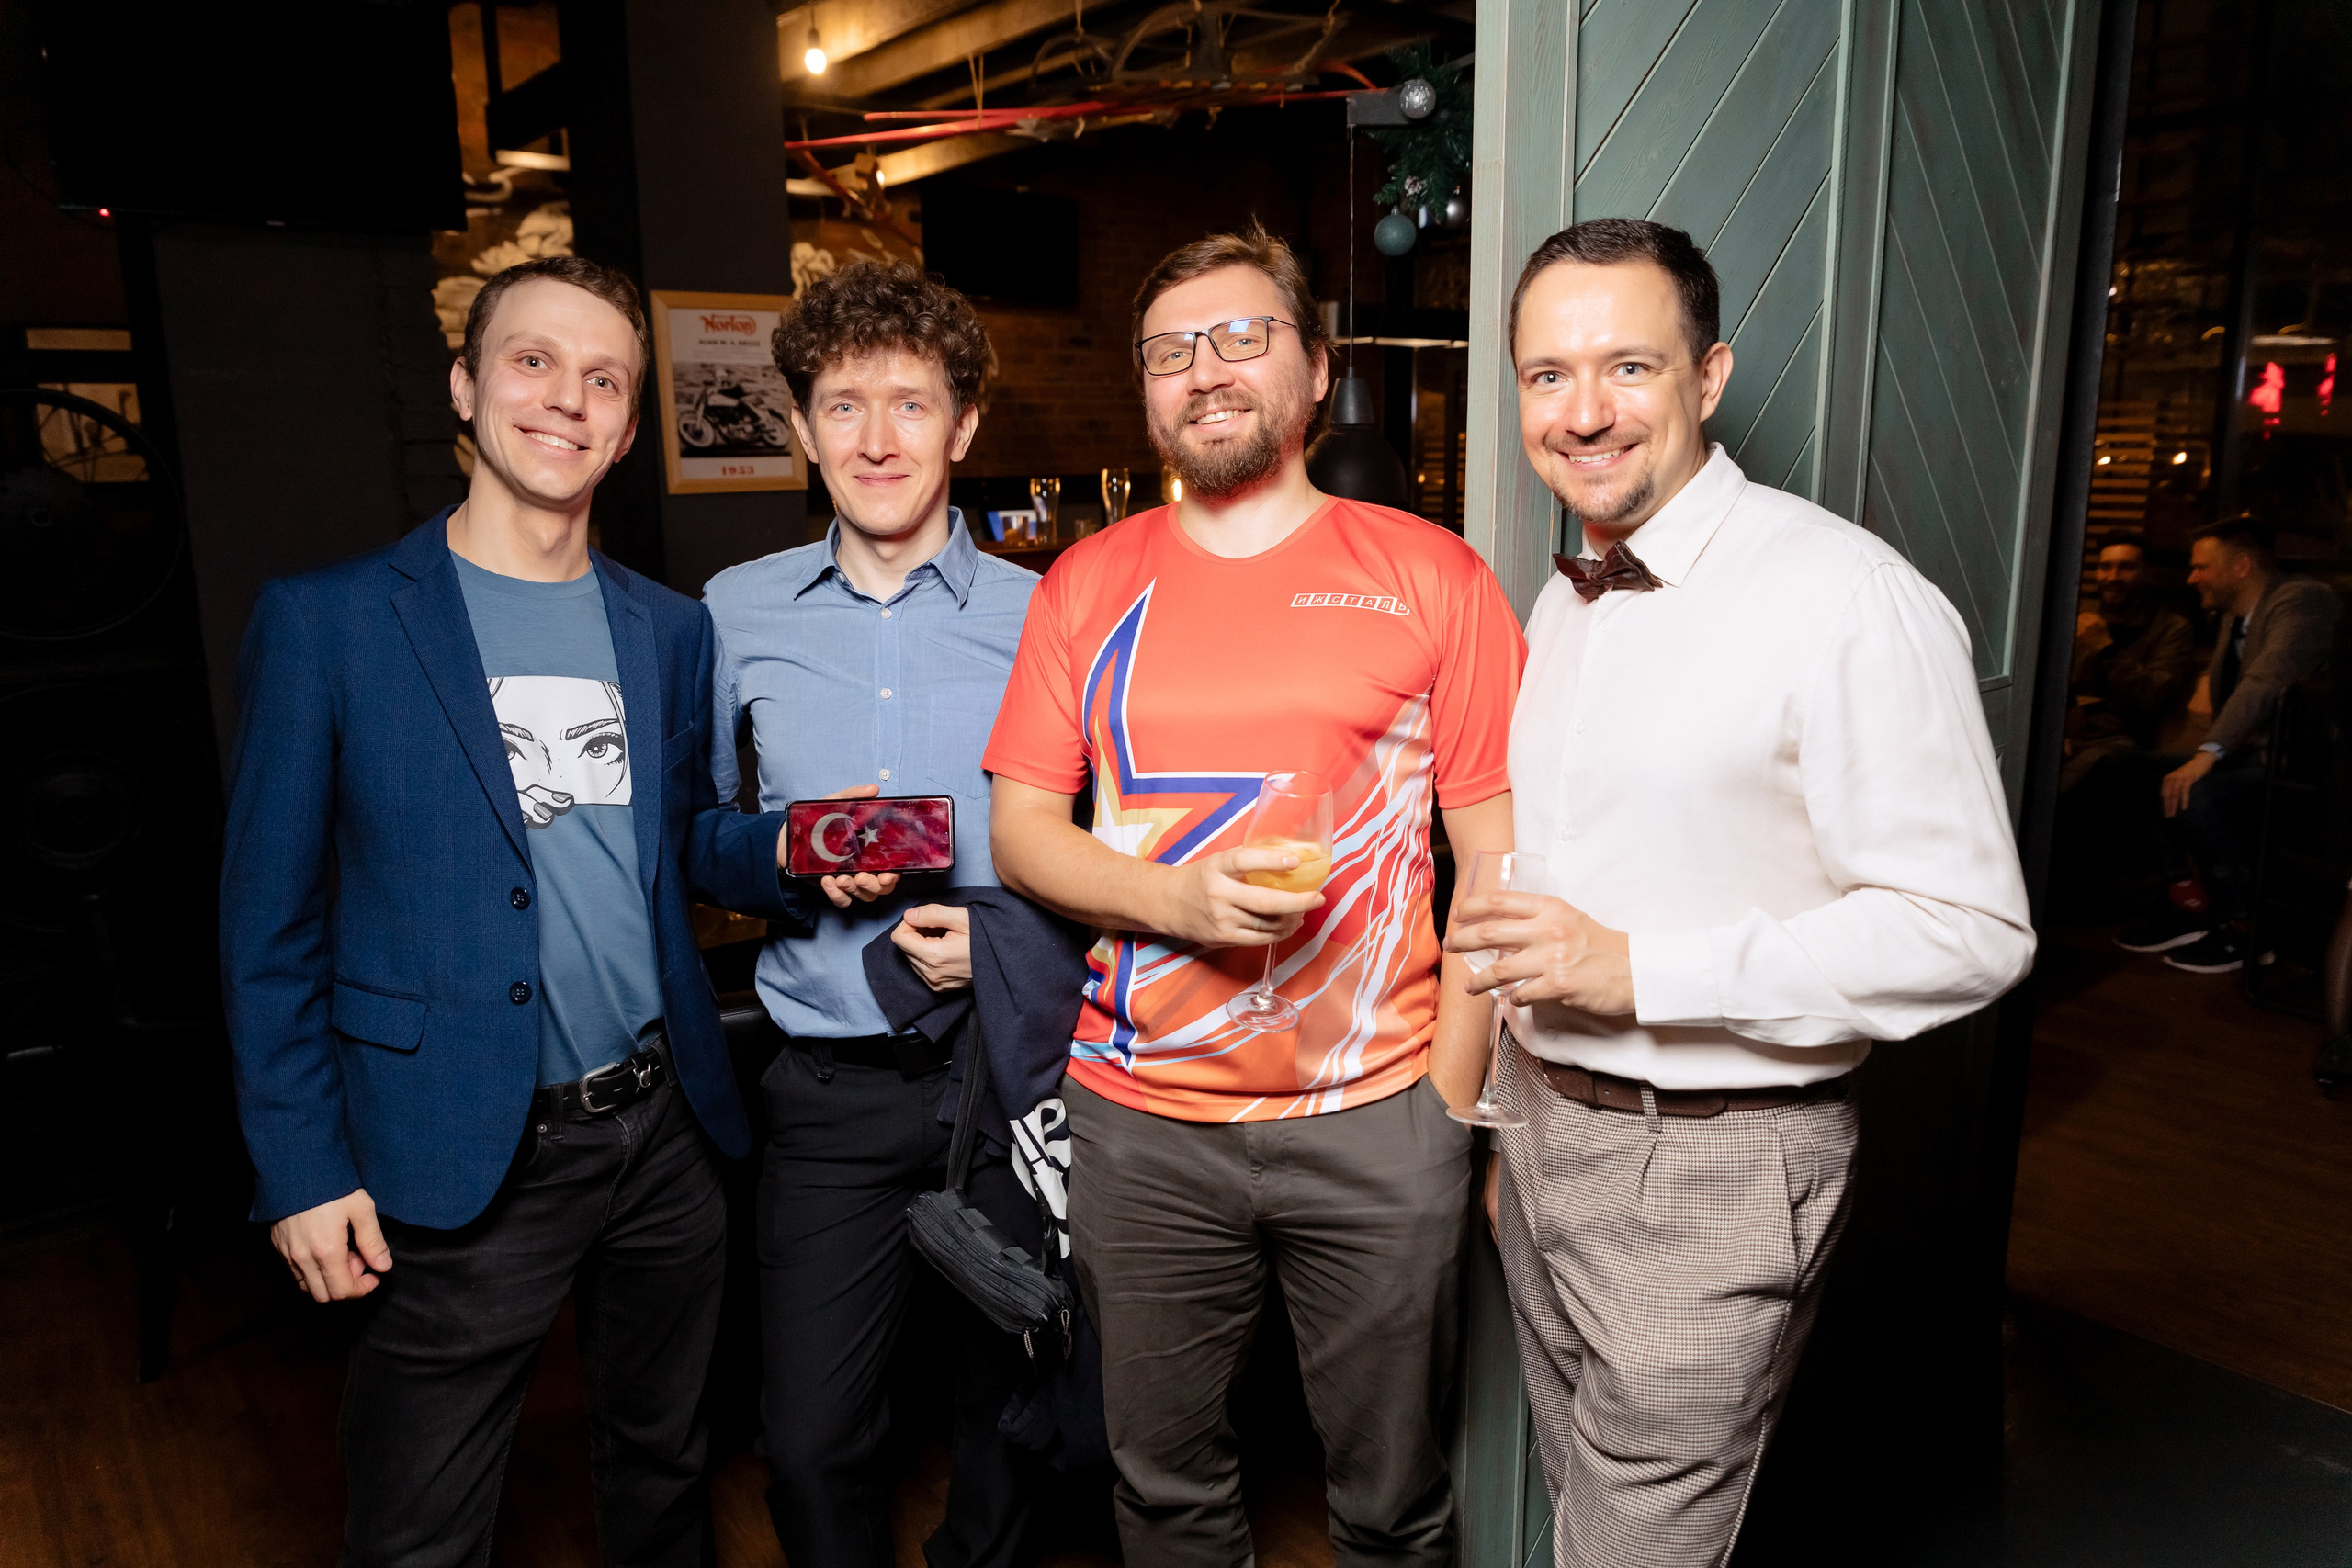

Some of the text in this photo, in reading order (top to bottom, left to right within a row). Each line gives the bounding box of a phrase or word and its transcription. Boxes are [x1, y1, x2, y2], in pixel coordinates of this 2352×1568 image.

[700, 313, 757, 336] Norton
[721, 464, 754, 476] 1953
[1294, 594, 1408, 613] ИЖСТАЛЬ
